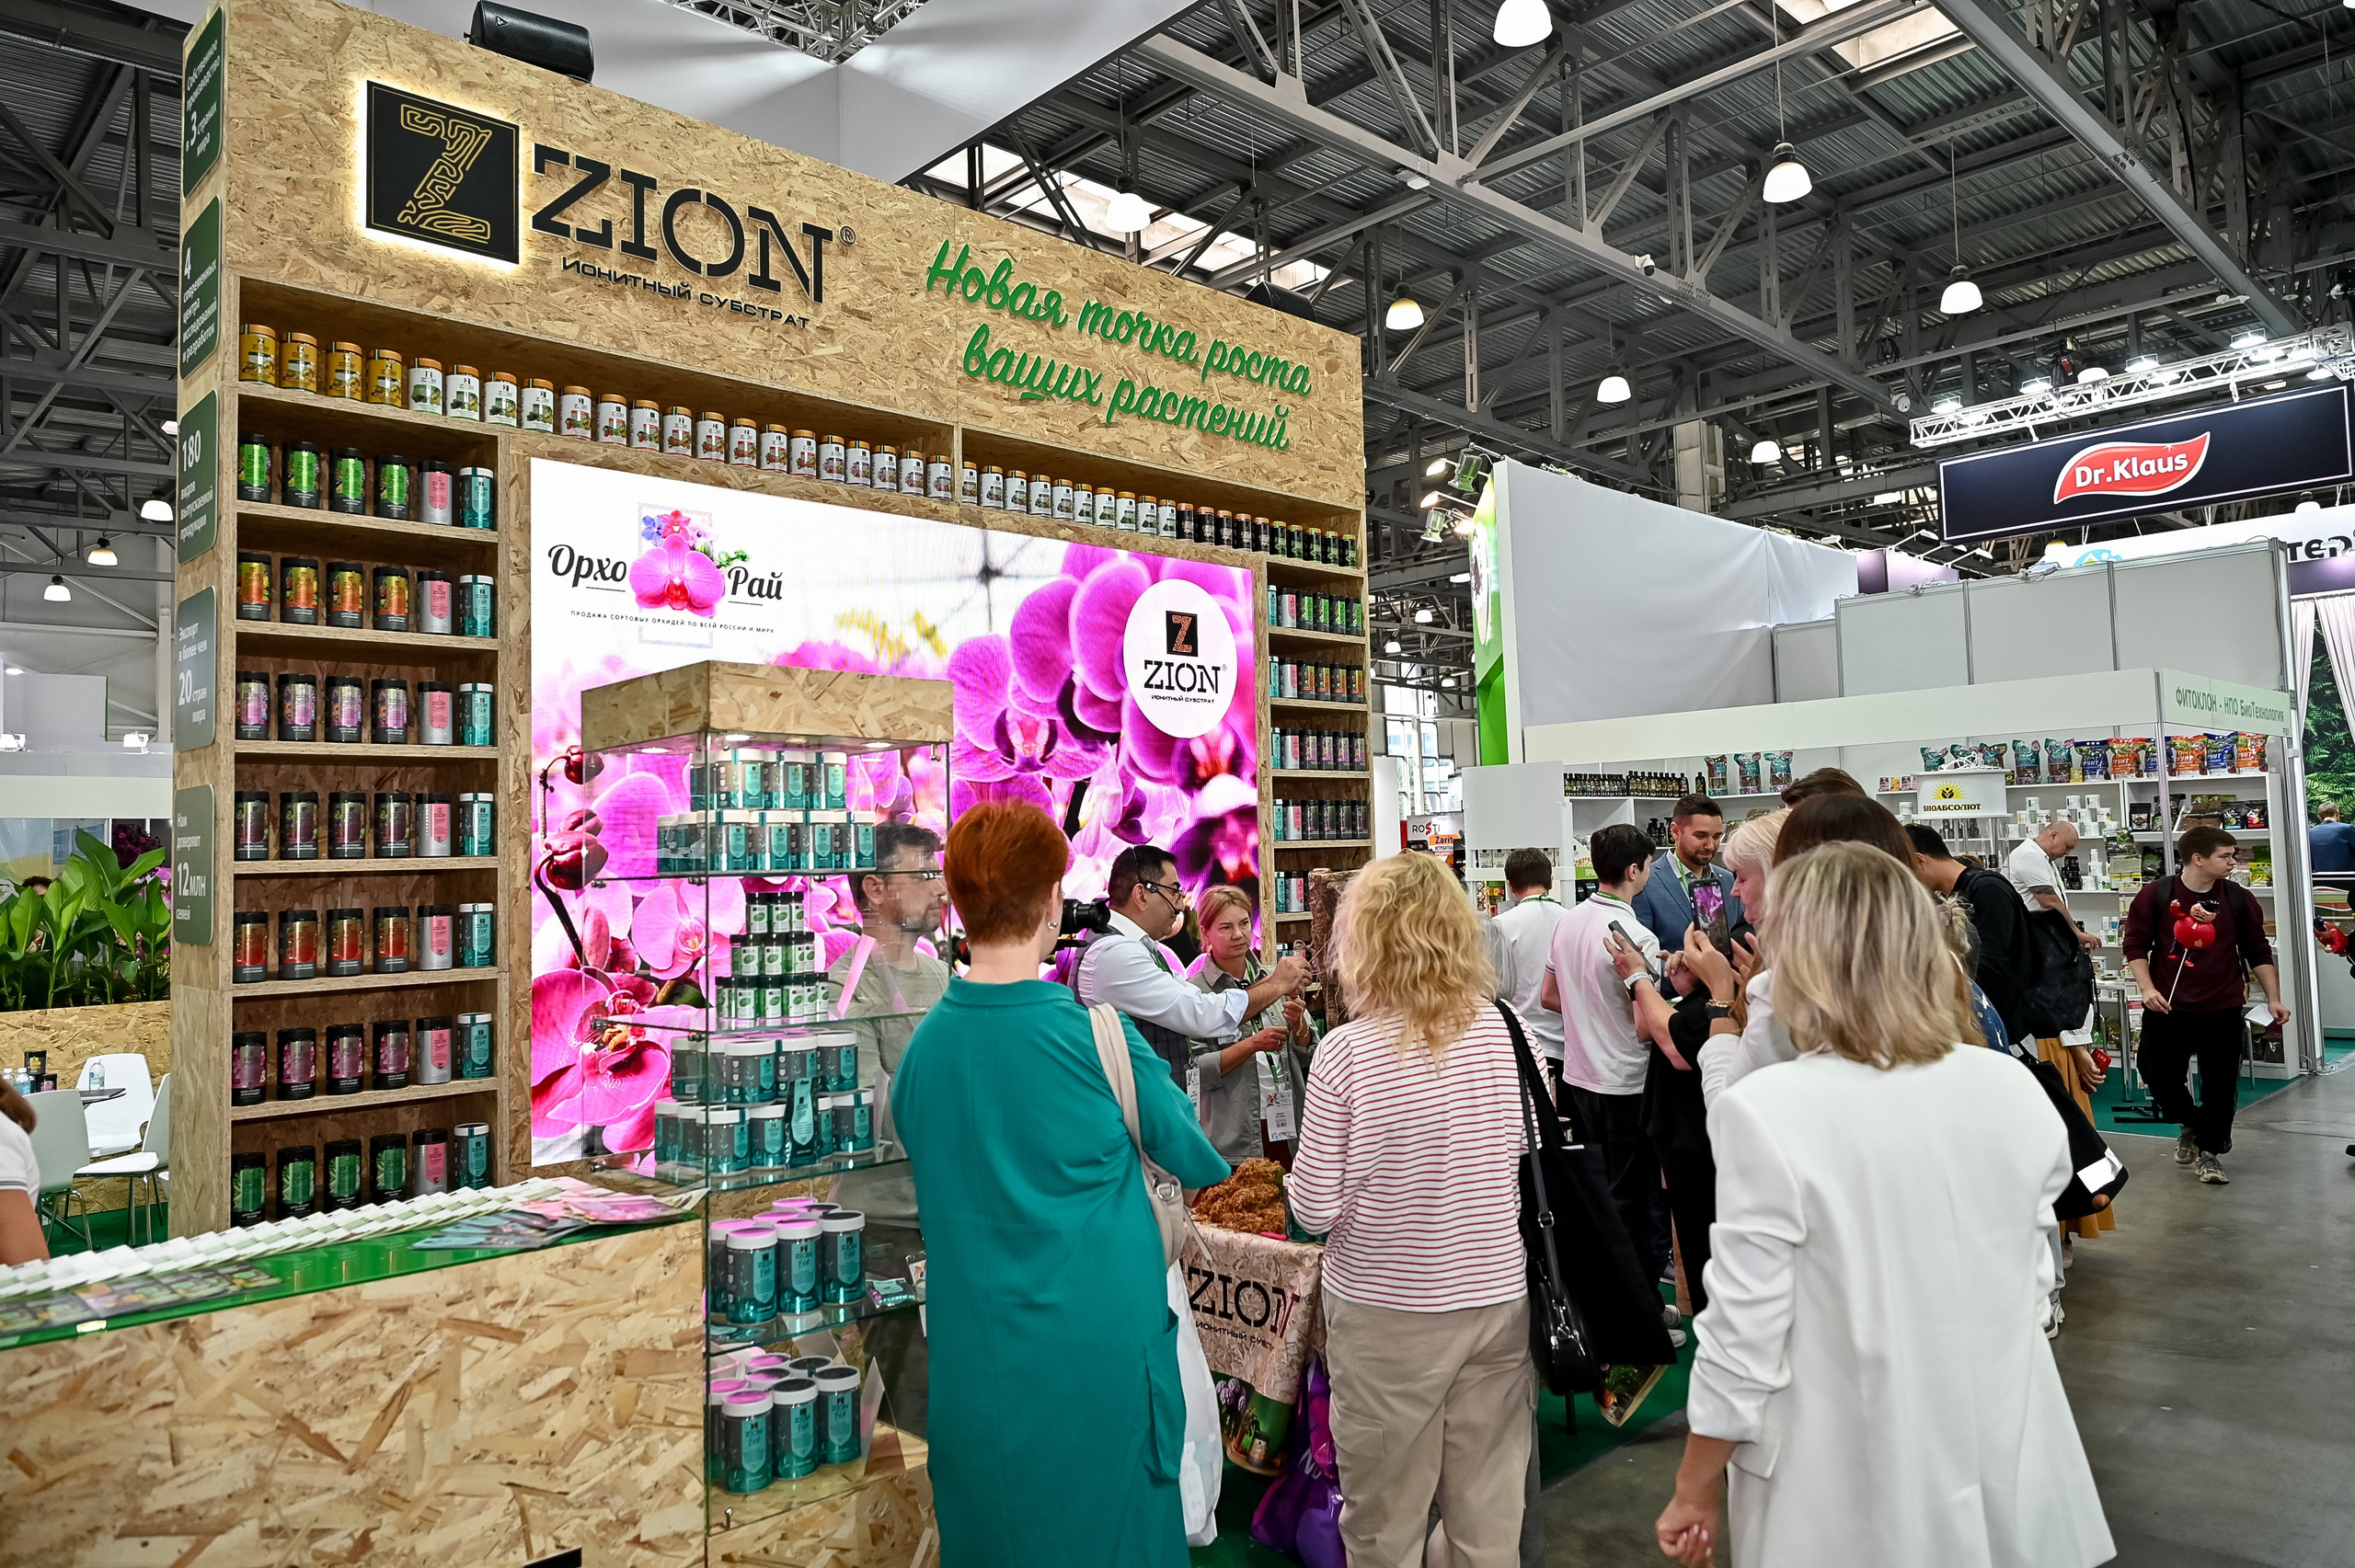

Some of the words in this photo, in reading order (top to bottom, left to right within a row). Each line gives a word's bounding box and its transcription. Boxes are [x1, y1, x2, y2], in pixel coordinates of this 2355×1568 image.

[187, 55, 220, 111] производство
[190, 111, 197, 146] 3
[197, 101, 217, 135] странах
[197, 132, 210, 157] мира
[532, 143, 833, 303] ZION
[183, 258, 217, 303] современных
[184, 246, 191, 280] 4
[182, 297, 201, 323] центра
[562, 257, 691, 301] ИОНИТНЫЙ
[698, 292, 810, 329] СУБСТРАТ
[182, 296, 217, 343] исследований
[926, 239, 1068, 327] Новая
[1076, 299, 1200, 365] точка
[1200, 338, 1313, 396] роста
[186, 322, 215, 362] разработок
[962, 324, 1104, 406] ваших
[1106, 377, 1290, 452] растений
[182, 429, 201, 472] 180
[2074, 452, 2188, 488] Dr.Klaus
[180, 481, 196, 500] видов
[180, 486, 213, 521] выпускаемой
[180, 514, 207, 543] продукции
[548, 544, 627, 588] Орхо
[728, 566, 783, 600] Рай
[178, 623, 199, 641] Экспорт
[570, 610, 607, 618] ПРОДАЖА
[610, 613, 649, 623] СОРТОВЫХ
[651, 617, 684, 625] ОРКИДЕЙ
[178, 650, 182, 662] в
[182, 644, 197, 660] более
[197, 639, 208, 654] чем
[178, 670, 193, 706] 20
[192, 687, 207, 705] стран
[1144, 659, 1221, 694] ZION
[1151, 694, 1184, 703] ИОНИТНЫЙ
[2176, 686, 2217, 713] ФИТОКЛОН
[2224, 696, 2238, 715] НПО
[2240, 699, 2284, 723] БиоТехнология
[192, 708, 206, 726] мира
[177, 813, 188, 828] Нам
[1412, 821, 1441, 835] ROSTI
[177, 835, 201, 852] доверяют
[178, 862, 189, 897] 12
[176, 906, 190, 921] семей
[1187, 1266, 1300, 1339] ZION
[1196, 1321, 1247, 1341] ИОНИТНЫЙ
[1249, 1334, 1275, 1352] СУБС
